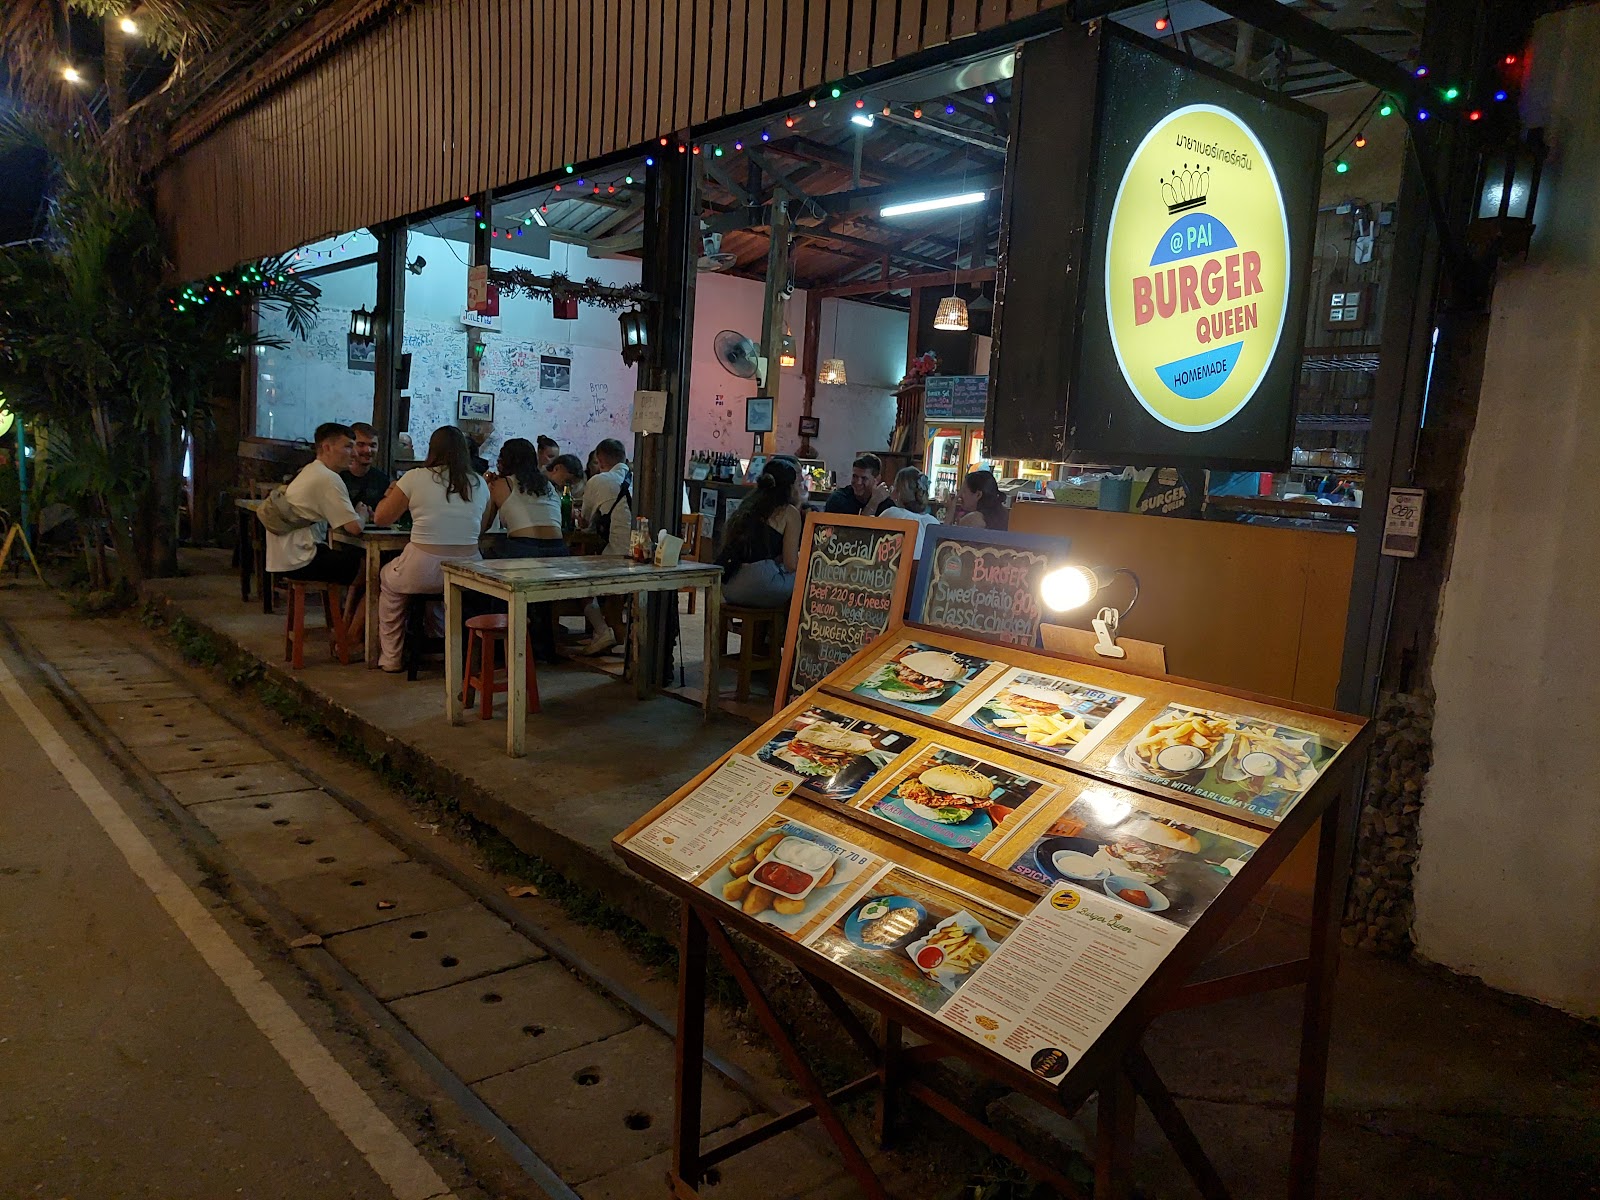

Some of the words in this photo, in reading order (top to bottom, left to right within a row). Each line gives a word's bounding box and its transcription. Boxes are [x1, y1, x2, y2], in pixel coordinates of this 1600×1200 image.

[1170, 232, 1183, 254] @
[1187, 222, 1212, 251] PAI
[1132, 251, 1264, 326] BURGER
[1196, 302, 1258, 344] QUEEN
[1174, 359, 1227, 387] HOMEMADE
[1140, 486, 1187, 512] BURGER
[828, 533, 875, 560] Special
[809, 584, 831, 600] Beef
[829, 587, 848, 601] 220
[811, 620, 847, 642] BURGER
[847, 628, 865, 645] Set
[1171, 780, 1194, 793] WITH
[903, 812, 930, 829] CHEESE
[930, 824, 955, 839] BACON
[845, 851, 860, 862] 70
[858, 857, 868, 865] B
[1015, 865, 1051, 883] SPICY
[1076, 907, 1107, 922] Burger
[1107, 919, 1132, 934] Queen
